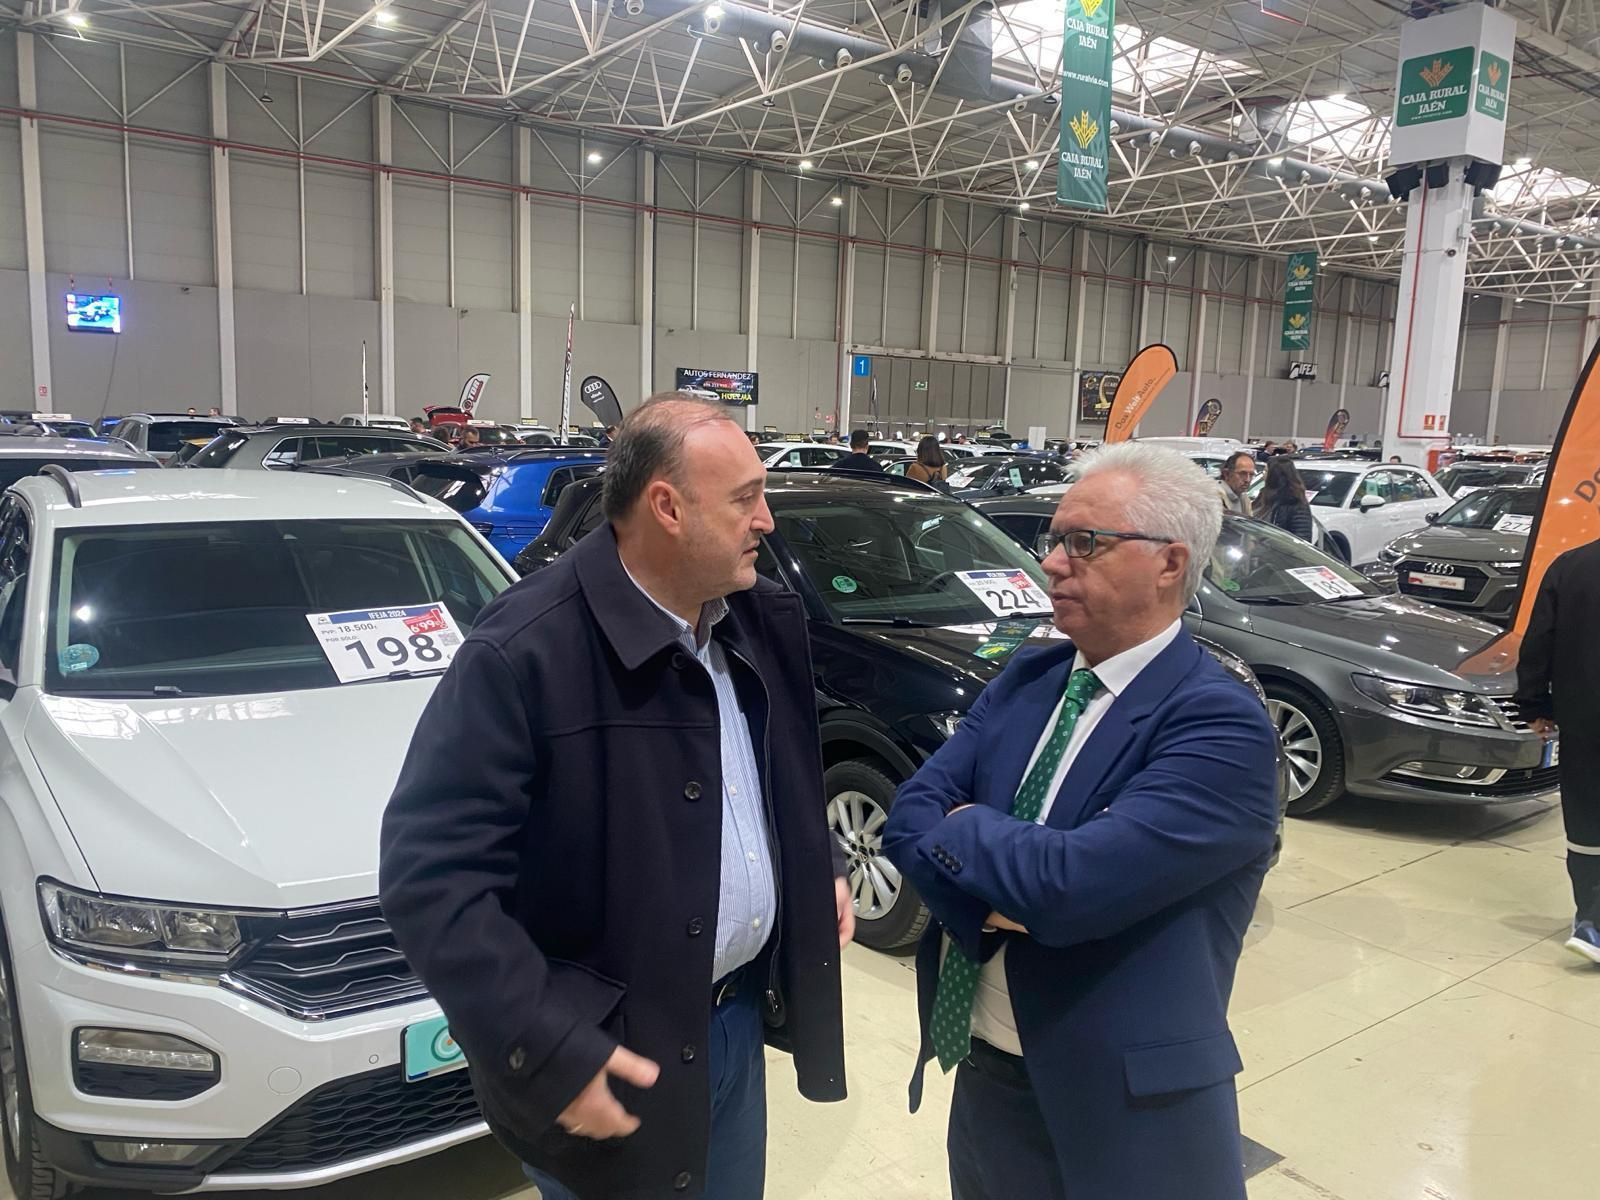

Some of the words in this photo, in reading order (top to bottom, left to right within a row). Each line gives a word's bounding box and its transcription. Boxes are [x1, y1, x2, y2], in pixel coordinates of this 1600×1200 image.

[1086, 23, 1109, 39] RURAL
[1063, 71, 1109, 88] www.ruralvia.com
[1429, 85, 1467, 100] RURAL
[1080, 155, 1104, 168] RURAL
[683, 369, 709, 378] AUTOS
[859, 359, 866, 374] 1
[721, 392, 752, 401] HUELMA
[986, 589, 1042, 610] 224
[368, 610, 388, 620] IFEJA
[388, 609, 407, 618] 2024
[345, 634, 443, 670] 198
